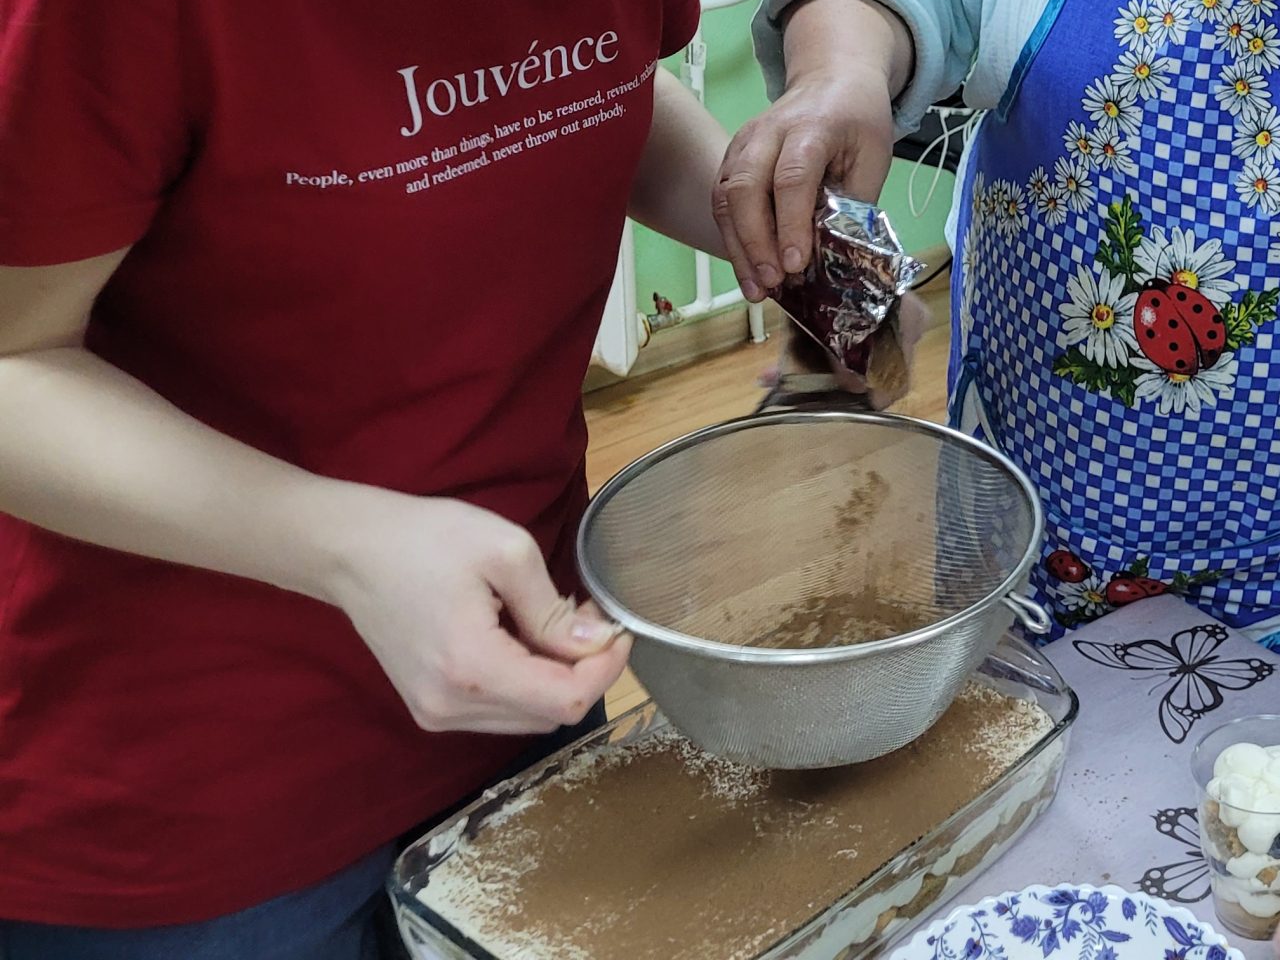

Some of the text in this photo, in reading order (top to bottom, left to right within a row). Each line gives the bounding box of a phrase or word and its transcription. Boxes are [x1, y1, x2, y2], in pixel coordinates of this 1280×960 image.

[397, 30, 618, 137] Jouvénce
[286, 170, 354, 189] People,
[357, 165, 394, 183] even
[396, 155, 429, 175] more
[431, 146, 458, 163] than
[459, 134, 495, 153] things,
[494, 124, 521, 139] have
[523, 115, 536, 129] to
[538, 109, 554, 124] be
[556, 90, 605, 118] restored,
[405, 172, 431, 194] and
[492, 140, 523, 161] never
[525, 133, 558, 149] throw
[560, 120, 581, 136] out
[582, 102, 627, 127] anybody.
